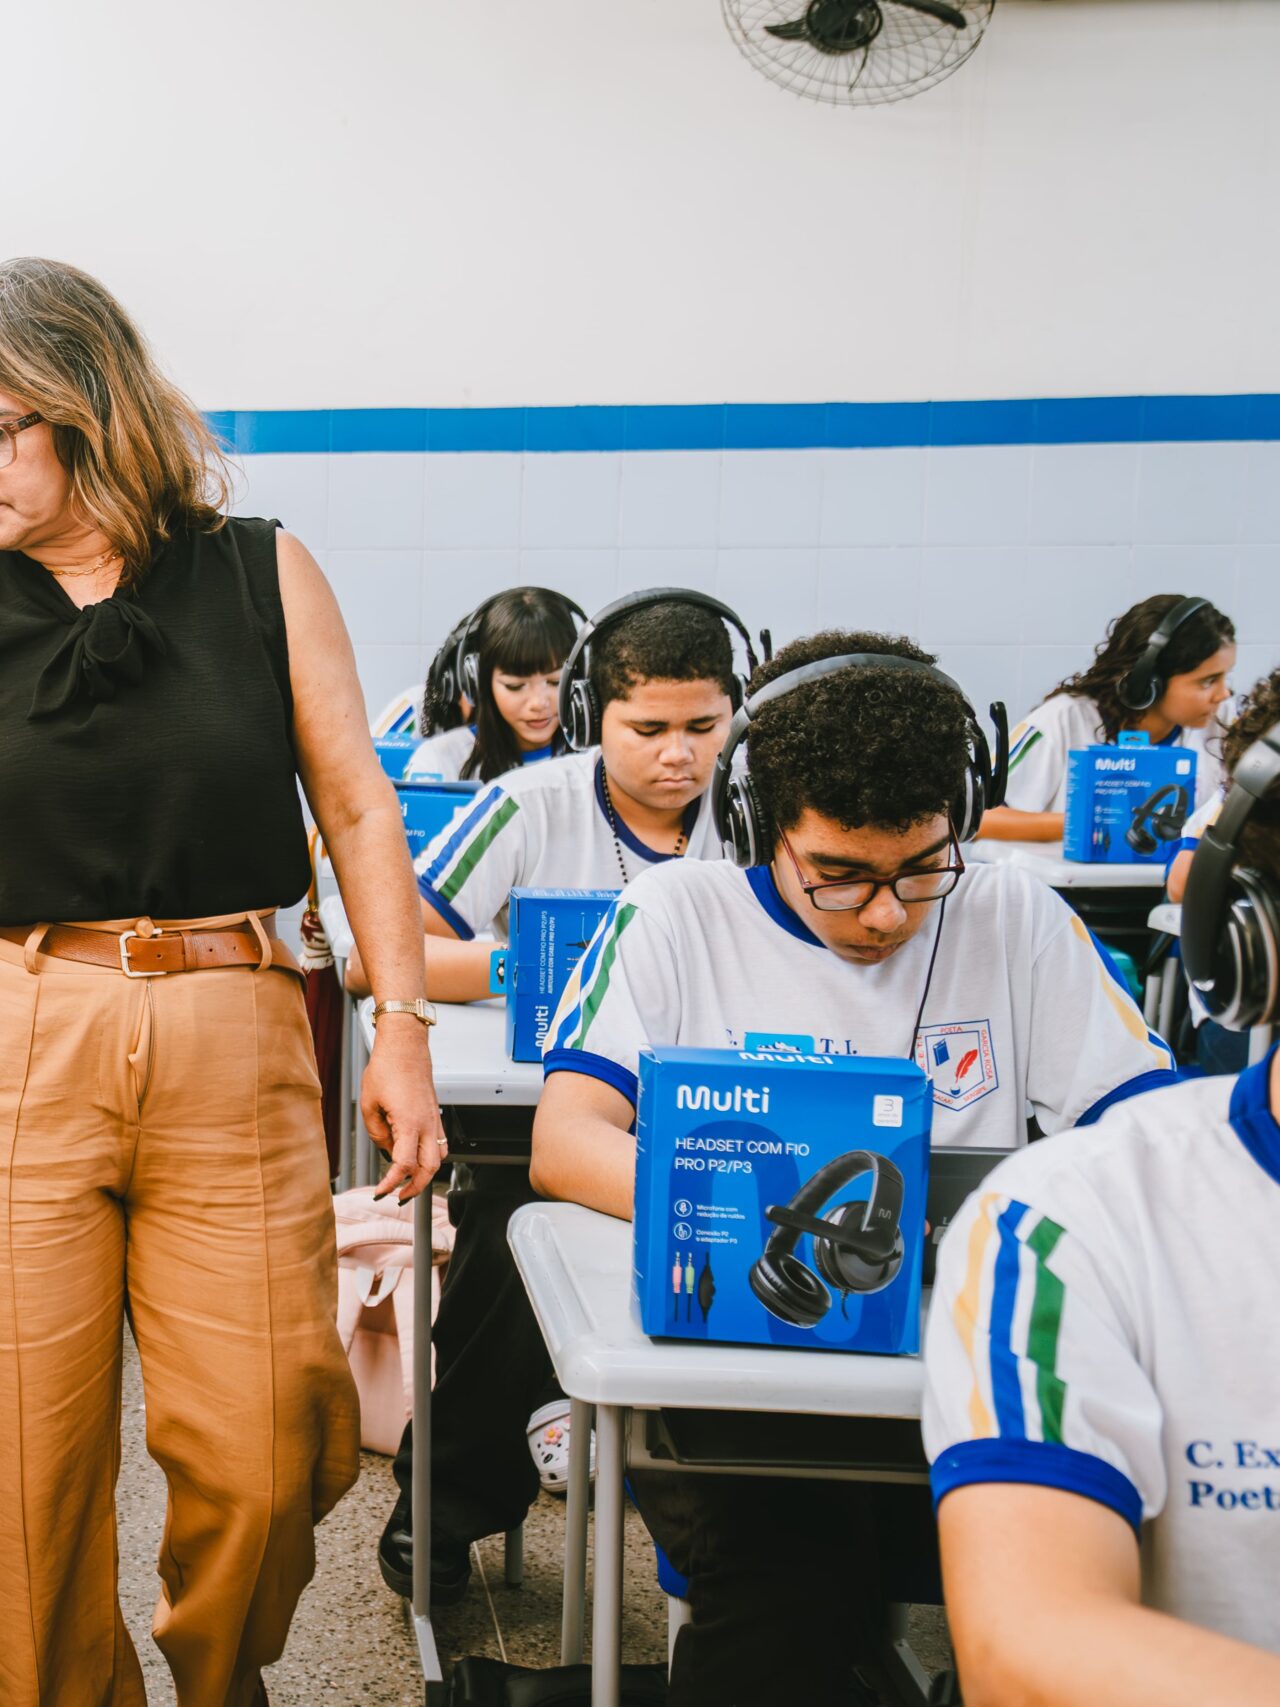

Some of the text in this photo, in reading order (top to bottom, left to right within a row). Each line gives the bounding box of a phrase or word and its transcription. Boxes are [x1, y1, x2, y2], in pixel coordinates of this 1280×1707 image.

[1094, 758, 1136, 771] Multi
[535, 1004, 549, 1049] Multi
[820, 1038, 858, 1055] T. I.
[738, 1051, 834, 1065] Multi
[984, 1059, 993, 1080] ROSA
[677, 1084, 770, 1114] Multi
[883, 1098, 895, 1112] 3
[675, 1137, 810, 1157] HEADSET COM FIO
[674, 1157, 753, 1174] PRO P2/P3
[1186, 1440, 1223, 1469] C.
[1187, 1480, 1280, 1511] Poet
